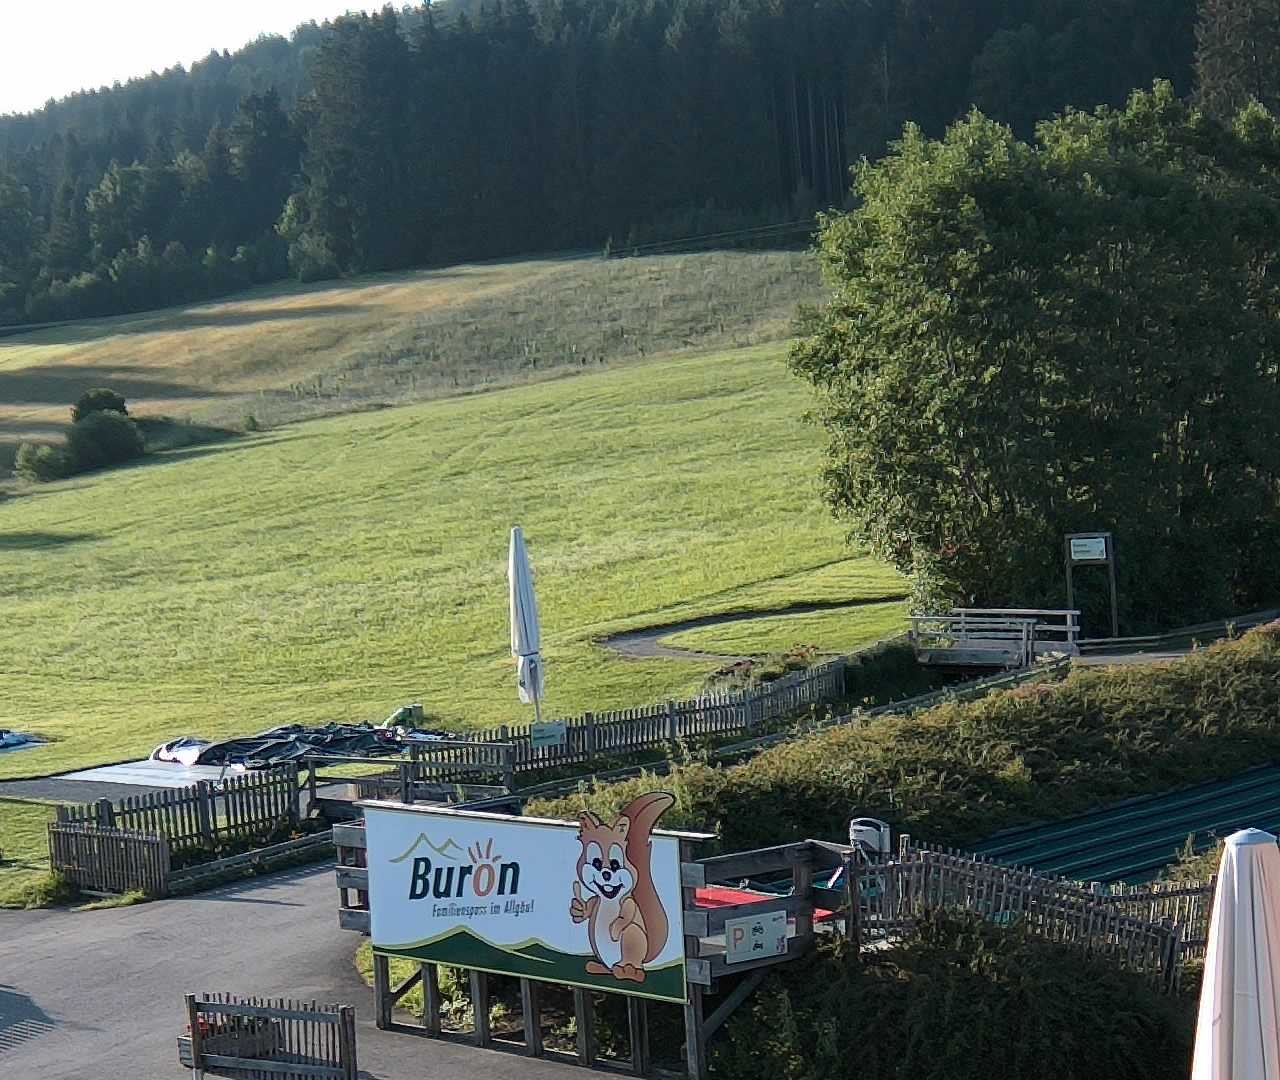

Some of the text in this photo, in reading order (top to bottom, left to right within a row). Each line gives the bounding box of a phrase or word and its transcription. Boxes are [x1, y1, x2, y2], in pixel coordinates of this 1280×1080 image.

[408, 856, 521, 900] Buron
[490, 901, 501, 915] im
[733, 928, 745, 951] P
